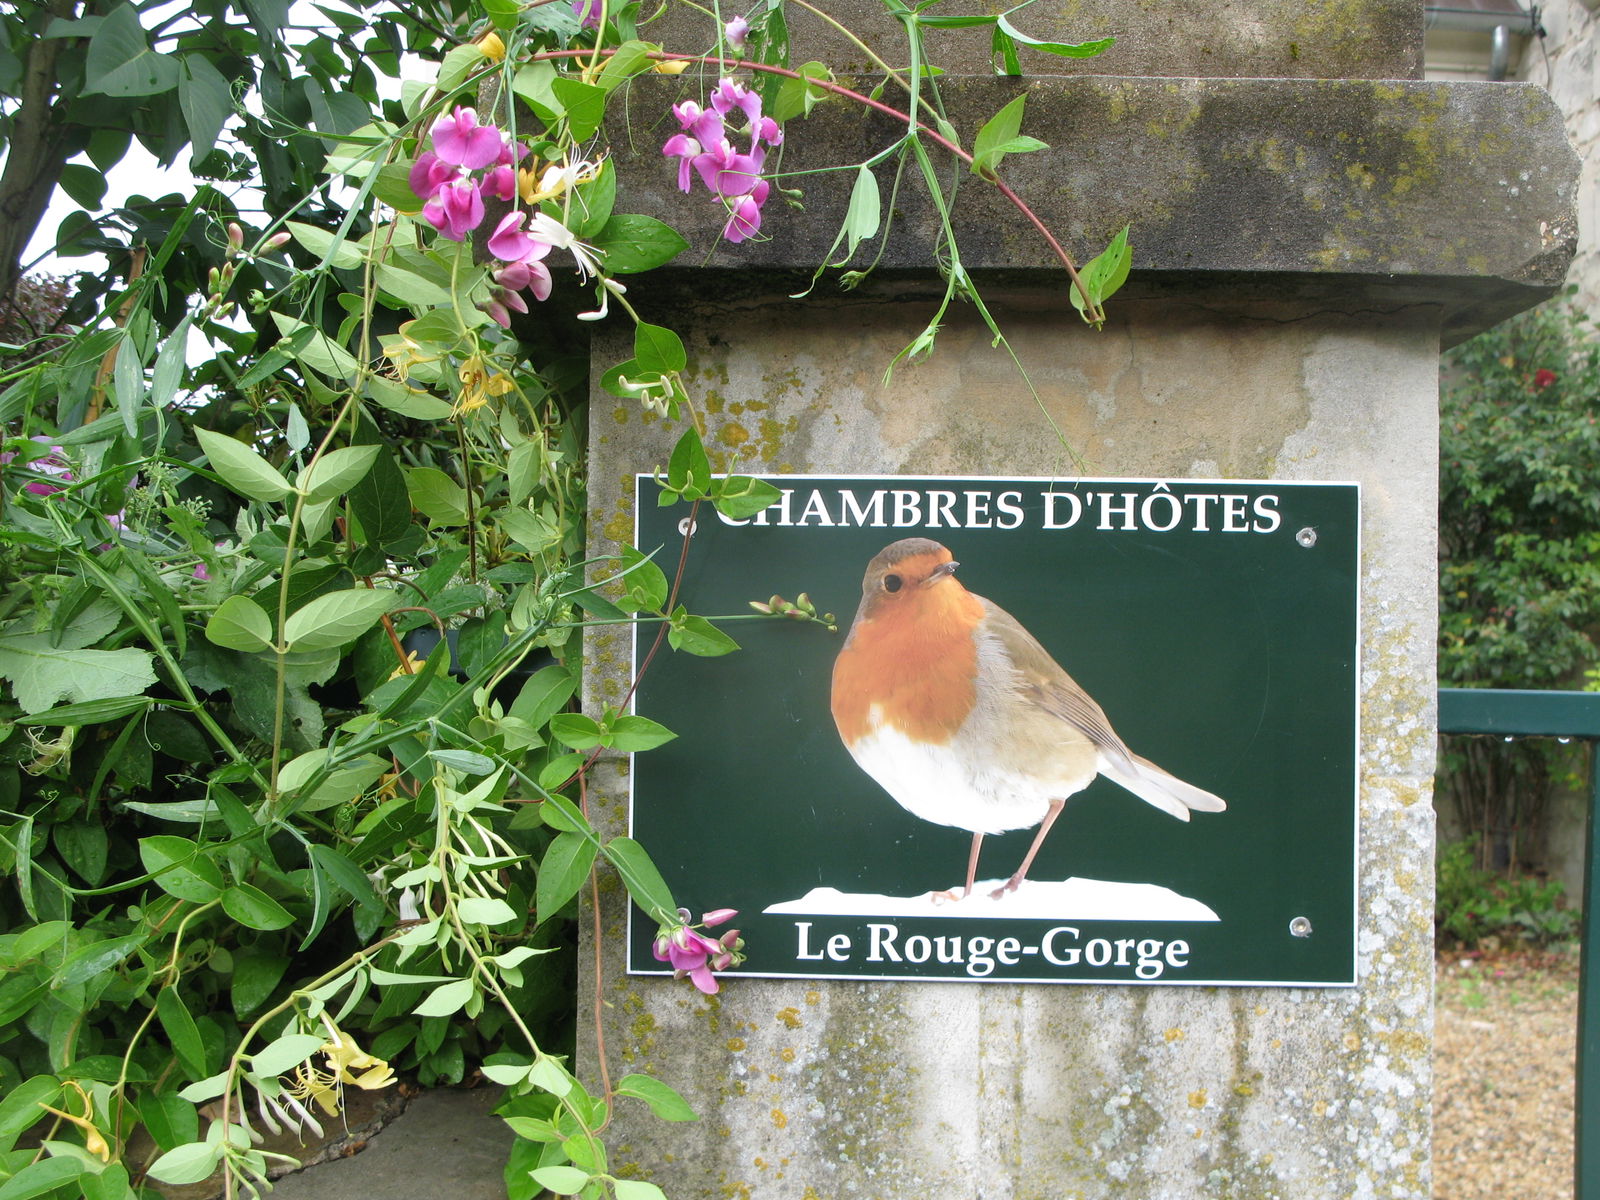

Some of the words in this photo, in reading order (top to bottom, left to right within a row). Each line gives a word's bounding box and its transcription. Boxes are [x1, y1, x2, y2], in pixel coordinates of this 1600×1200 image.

[716, 488, 1025, 531] HAMBRES
[1040, 481, 1282, 533] D'HÔTES
[794, 921, 852, 963] Le
[865, 923, 1191, 980] Rouge-Gorge
